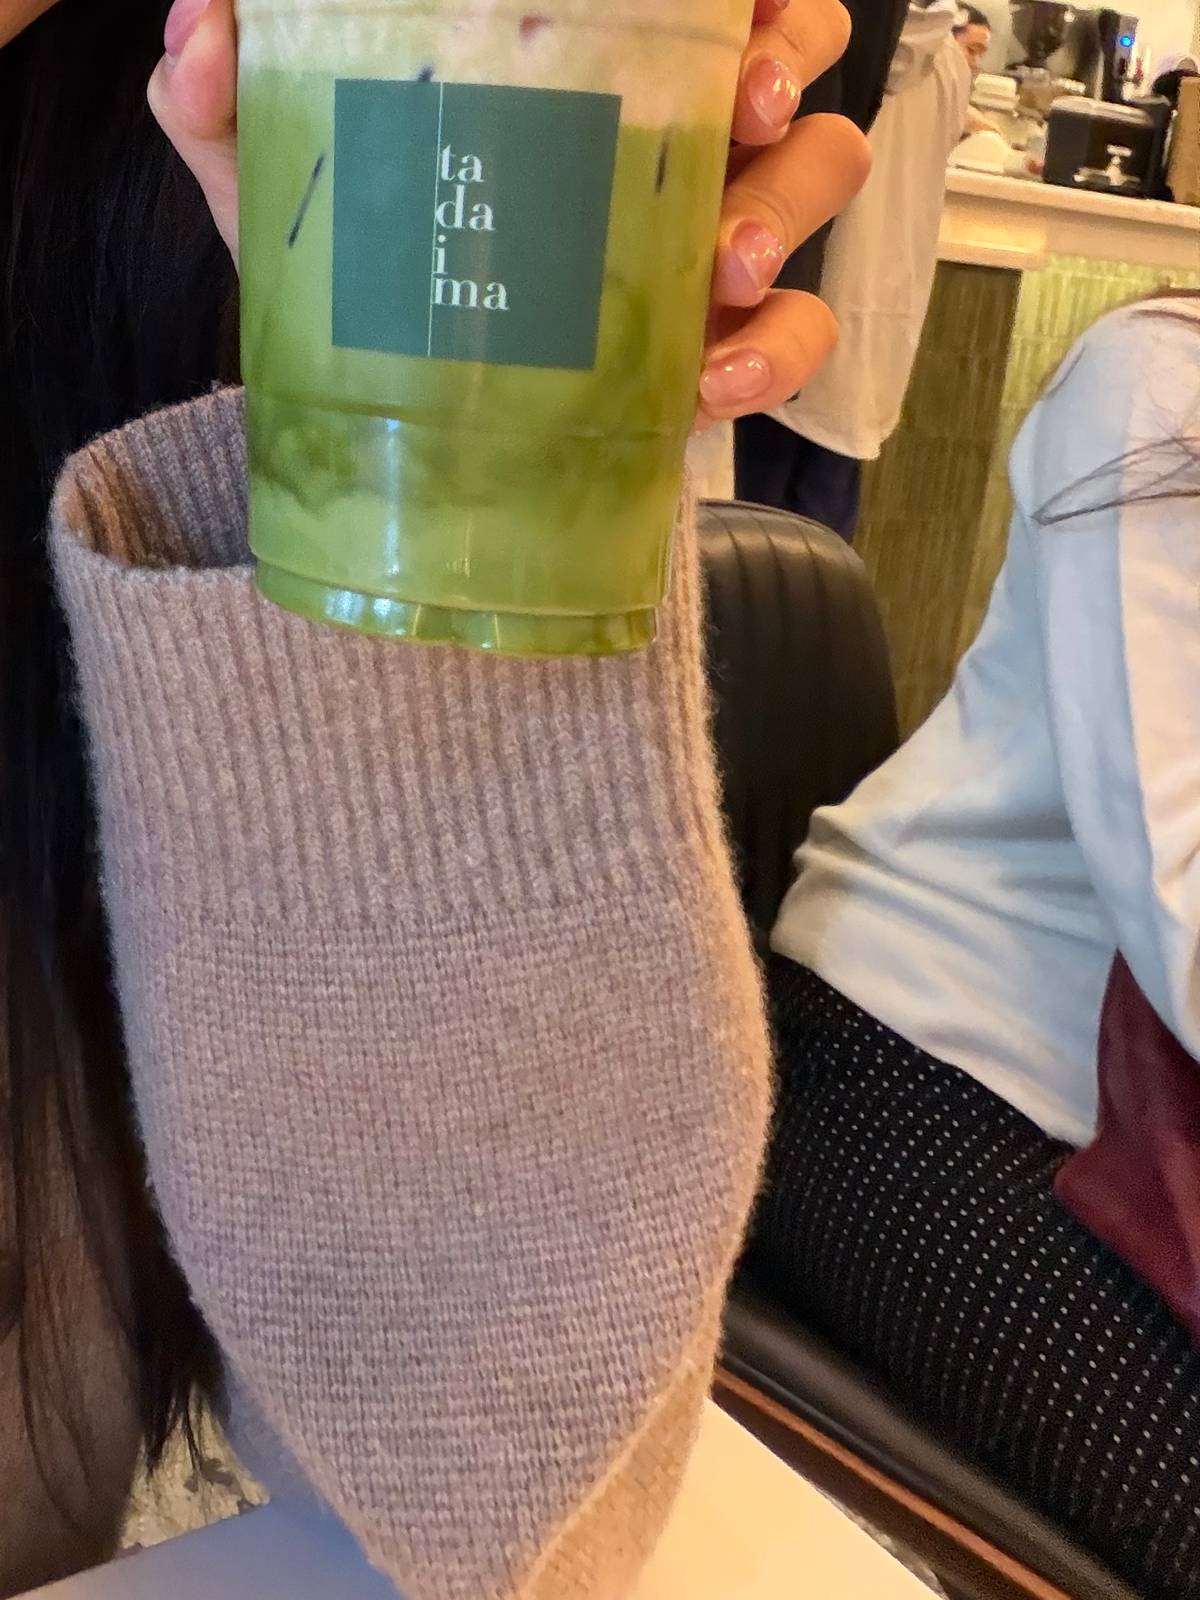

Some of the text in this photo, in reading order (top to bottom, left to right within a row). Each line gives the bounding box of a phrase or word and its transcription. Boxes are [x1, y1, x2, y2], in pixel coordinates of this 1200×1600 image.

[439, 143, 485, 183] ta
[434, 183, 496, 231] da
[432, 234, 448, 275] i
[432, 276, 509, 311] ma
